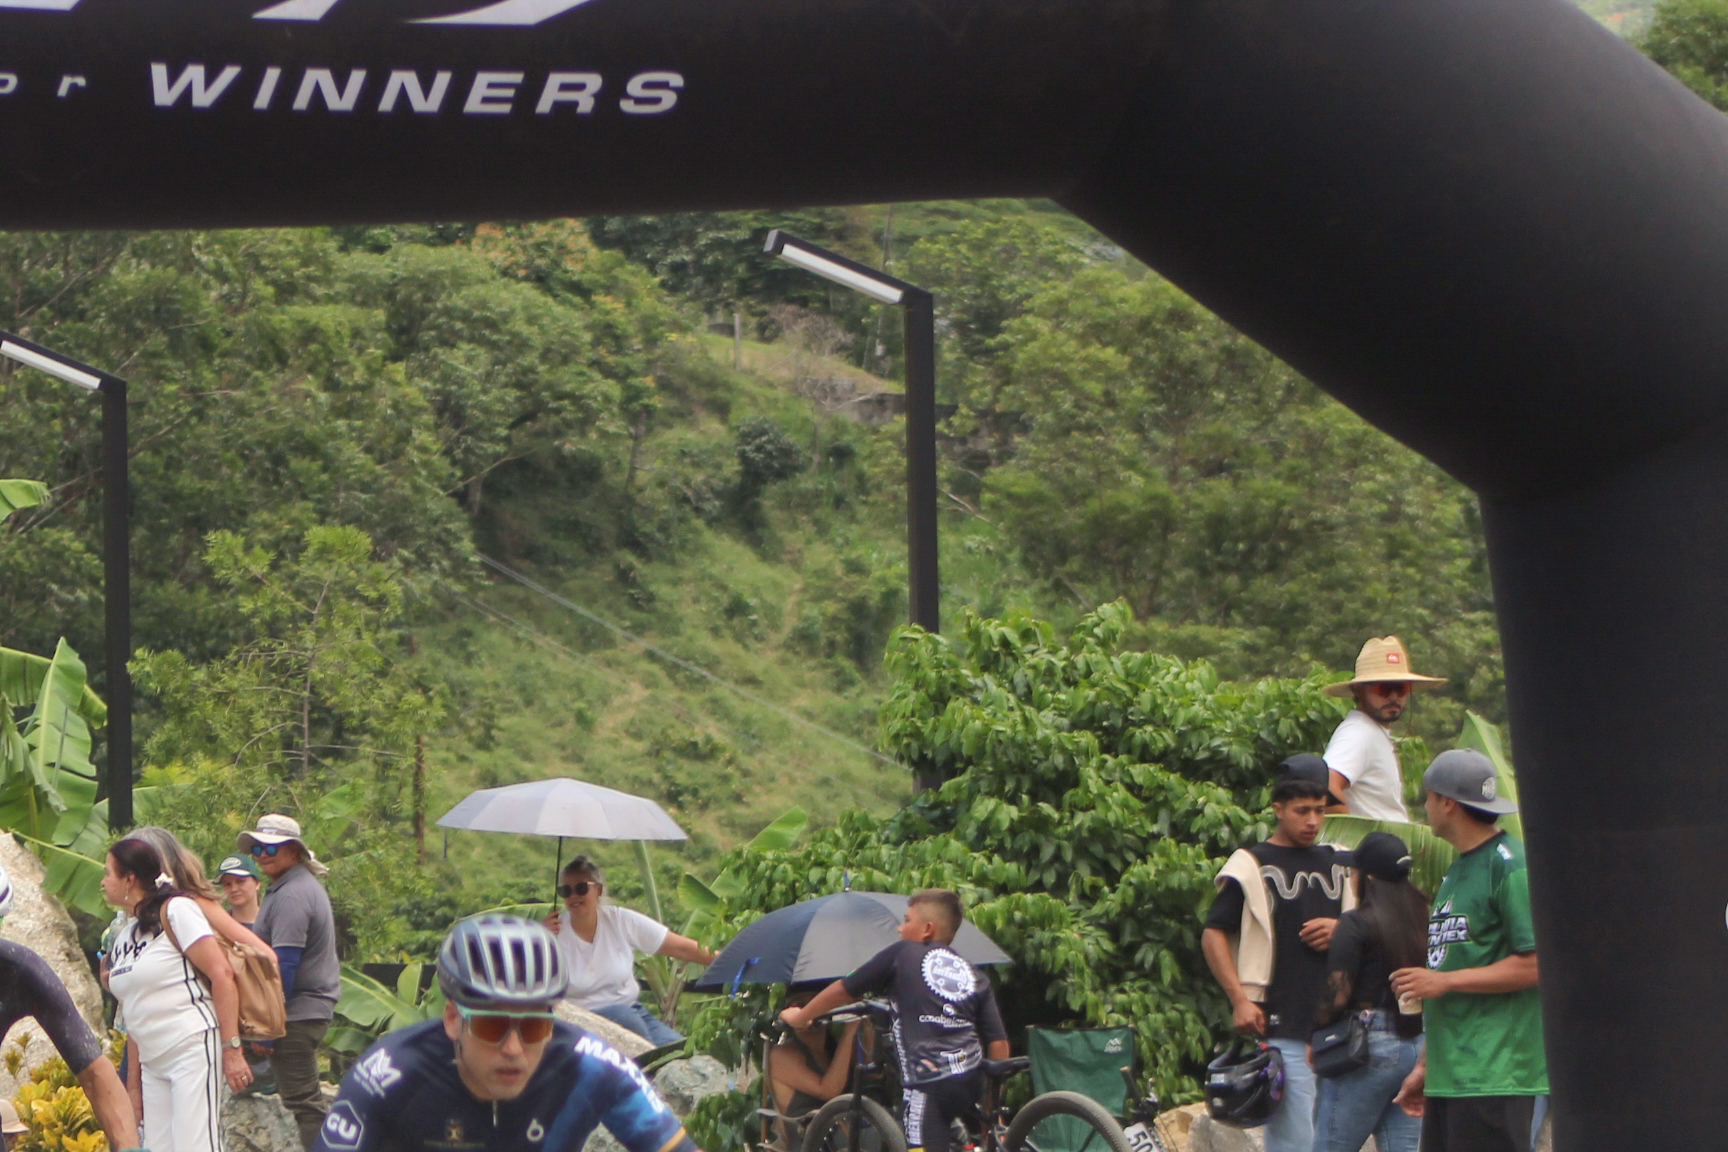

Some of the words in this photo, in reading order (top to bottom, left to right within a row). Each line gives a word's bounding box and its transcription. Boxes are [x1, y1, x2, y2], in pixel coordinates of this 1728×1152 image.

[150, 61, 685, 115] WINNERS
[573, 1035, 666, 1115] MAXXIS
[326, 1112, 358, 1140] GU
